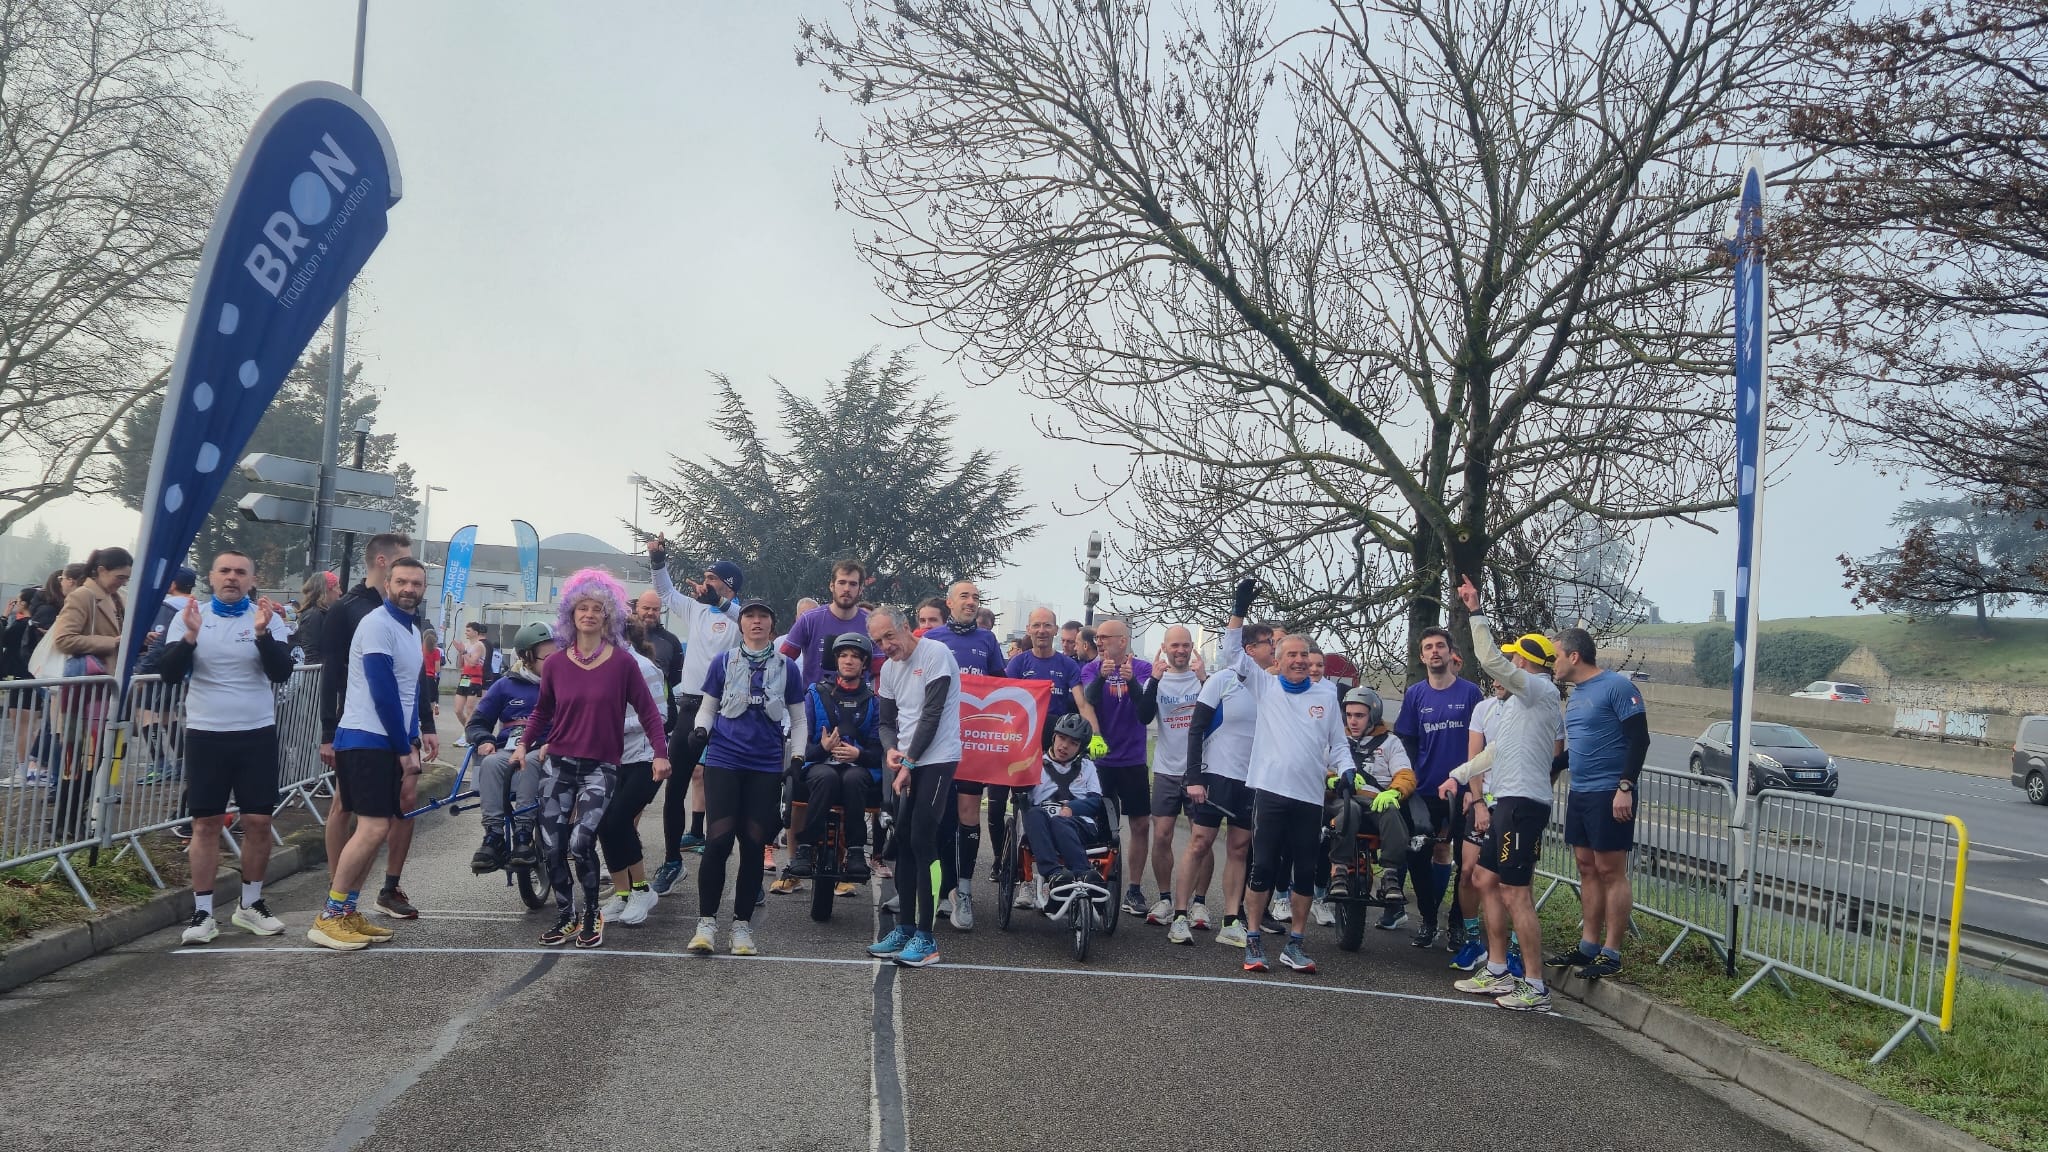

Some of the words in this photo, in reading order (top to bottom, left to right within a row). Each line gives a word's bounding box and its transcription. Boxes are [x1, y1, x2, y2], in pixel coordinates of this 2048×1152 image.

[243, 131, 358, 298] BRON
[277, 254, 322, 309] Tradition
[318, 242, 328, 255] &
[960, 740, 1009, 752] 'ÉTOILES
[964, 730, 1023, 742] PORTEURS
